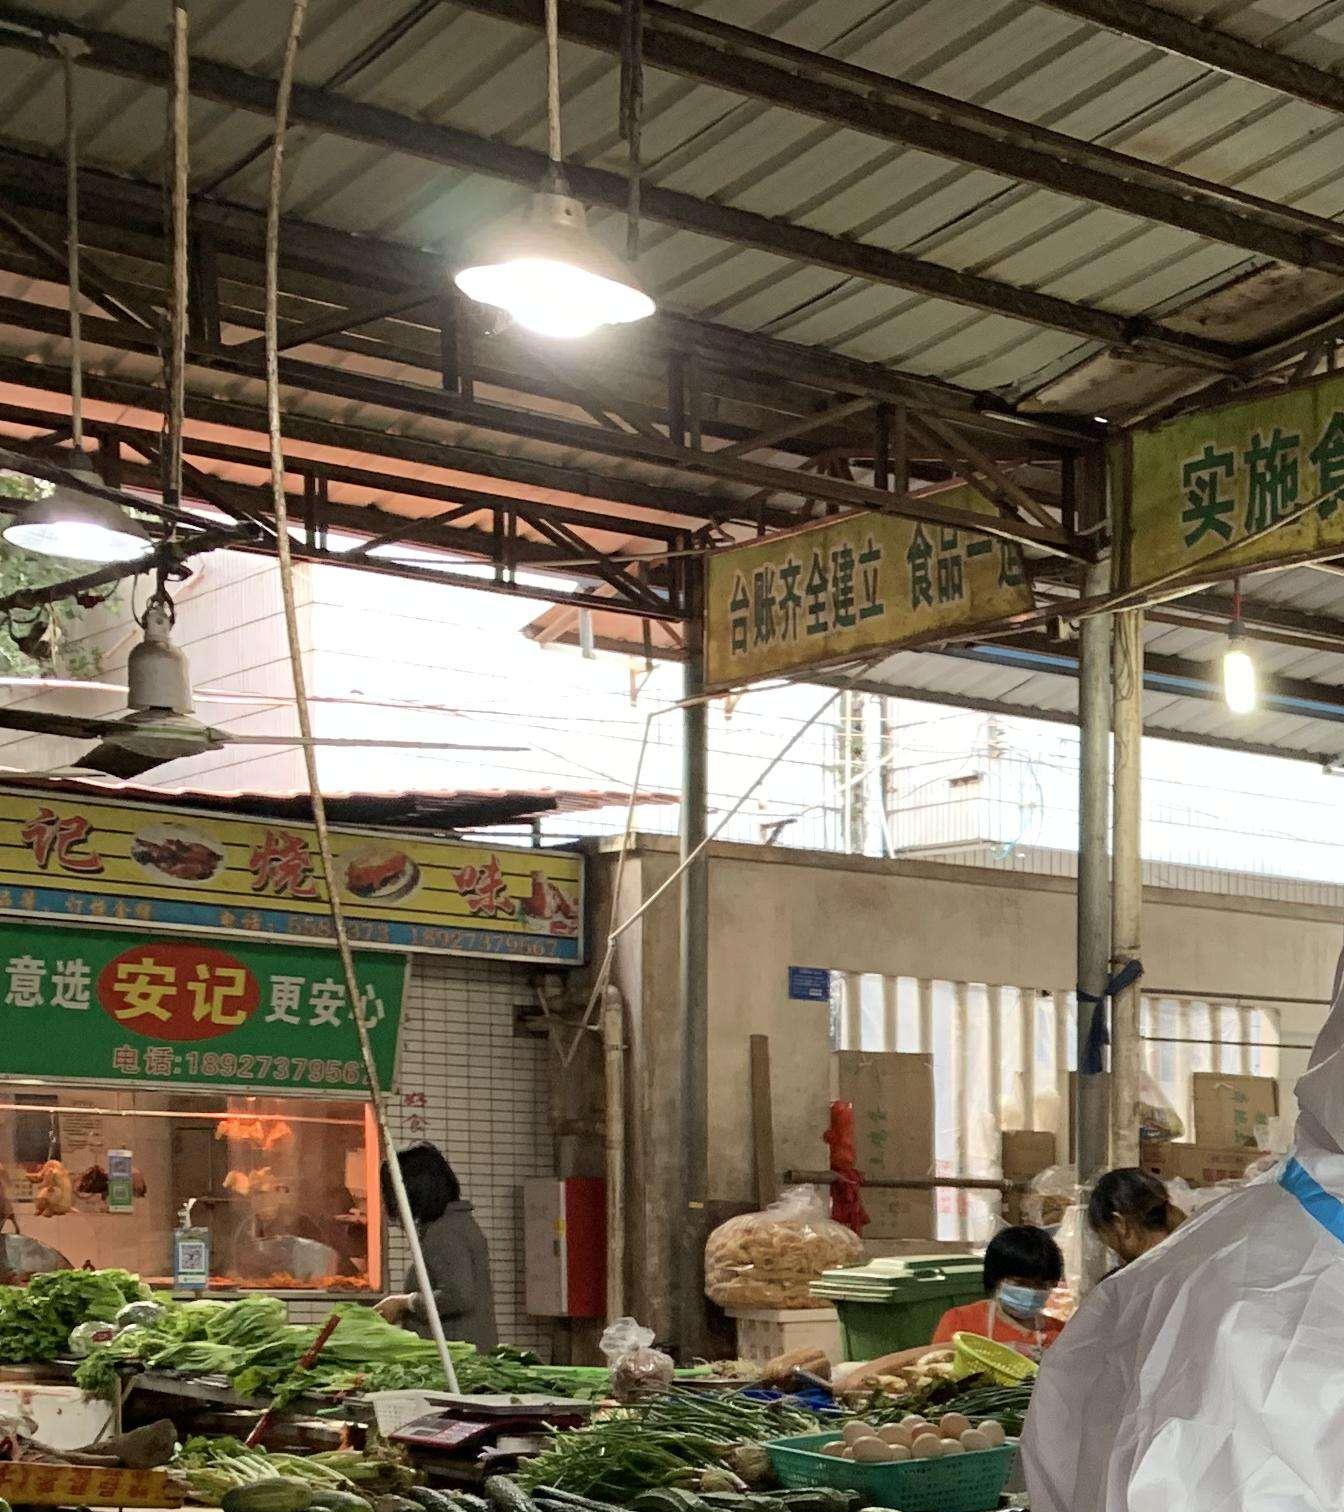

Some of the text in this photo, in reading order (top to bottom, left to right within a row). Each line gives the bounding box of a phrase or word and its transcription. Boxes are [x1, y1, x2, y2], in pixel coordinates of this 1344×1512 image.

[728, 541, 885, 656] 台账齐全建立
[20, 807, 515, 916] 记 烧 味
[5, 955, 386, 1029] 意选 安记 更安心
